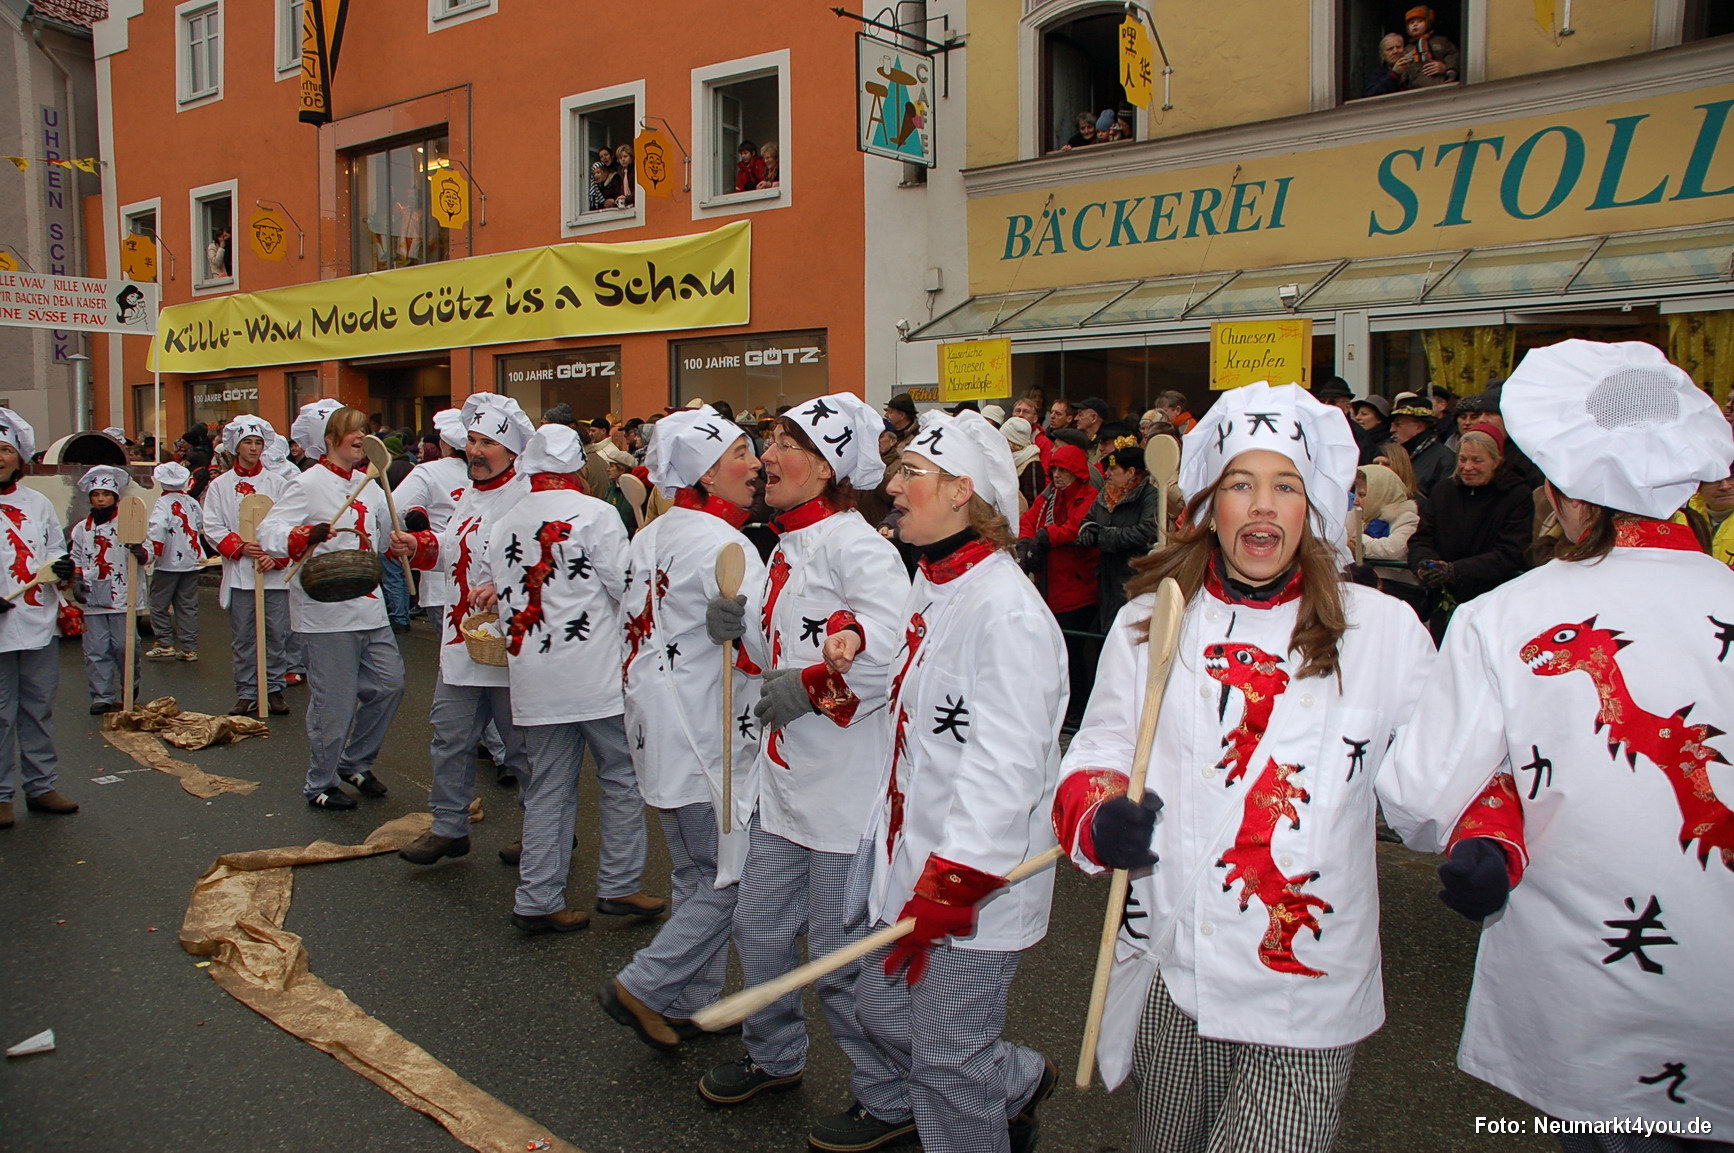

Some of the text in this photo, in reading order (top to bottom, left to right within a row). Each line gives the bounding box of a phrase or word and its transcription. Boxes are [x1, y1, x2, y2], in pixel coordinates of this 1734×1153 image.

[1000, 99, 1734, 261] BÄCKEREI STOLL
[44, 108, 68, 361] UHREN SCHCK
[19, 276, 46, 289] WAU
[53, 279, 79, 292] KILLE
[81, 281, 107, 294] WAU
[0, 291, 107, 310] IR BACKEN DEM KAISER
[311, 296, 398, 338] Mode
[408, 286, 494, 327] Götz
[505, 277, 544, 315] is
[555, 285, 582, 310] a
[594, 260, 735, 307] Schau
[28, 307, 67, 323] SÜSSE
[73, 312, 108, 326] FRAU
[1220, 327, 1276, 344] Chinesen
[683, 347, 819, 371] 100 JAHRE GÖTZ
[948, 360, 985, 375] Chinesen
[1224, 349, 1285, 372] Krapfen
[508, 361, 616, 382] 100 JAHRE GÖTZ
[948, 373, 992, 393] Mohrenköpfe
[204, 393, 222, 403] JAHRE
[223, 388, 258, 401] GÖTZ
